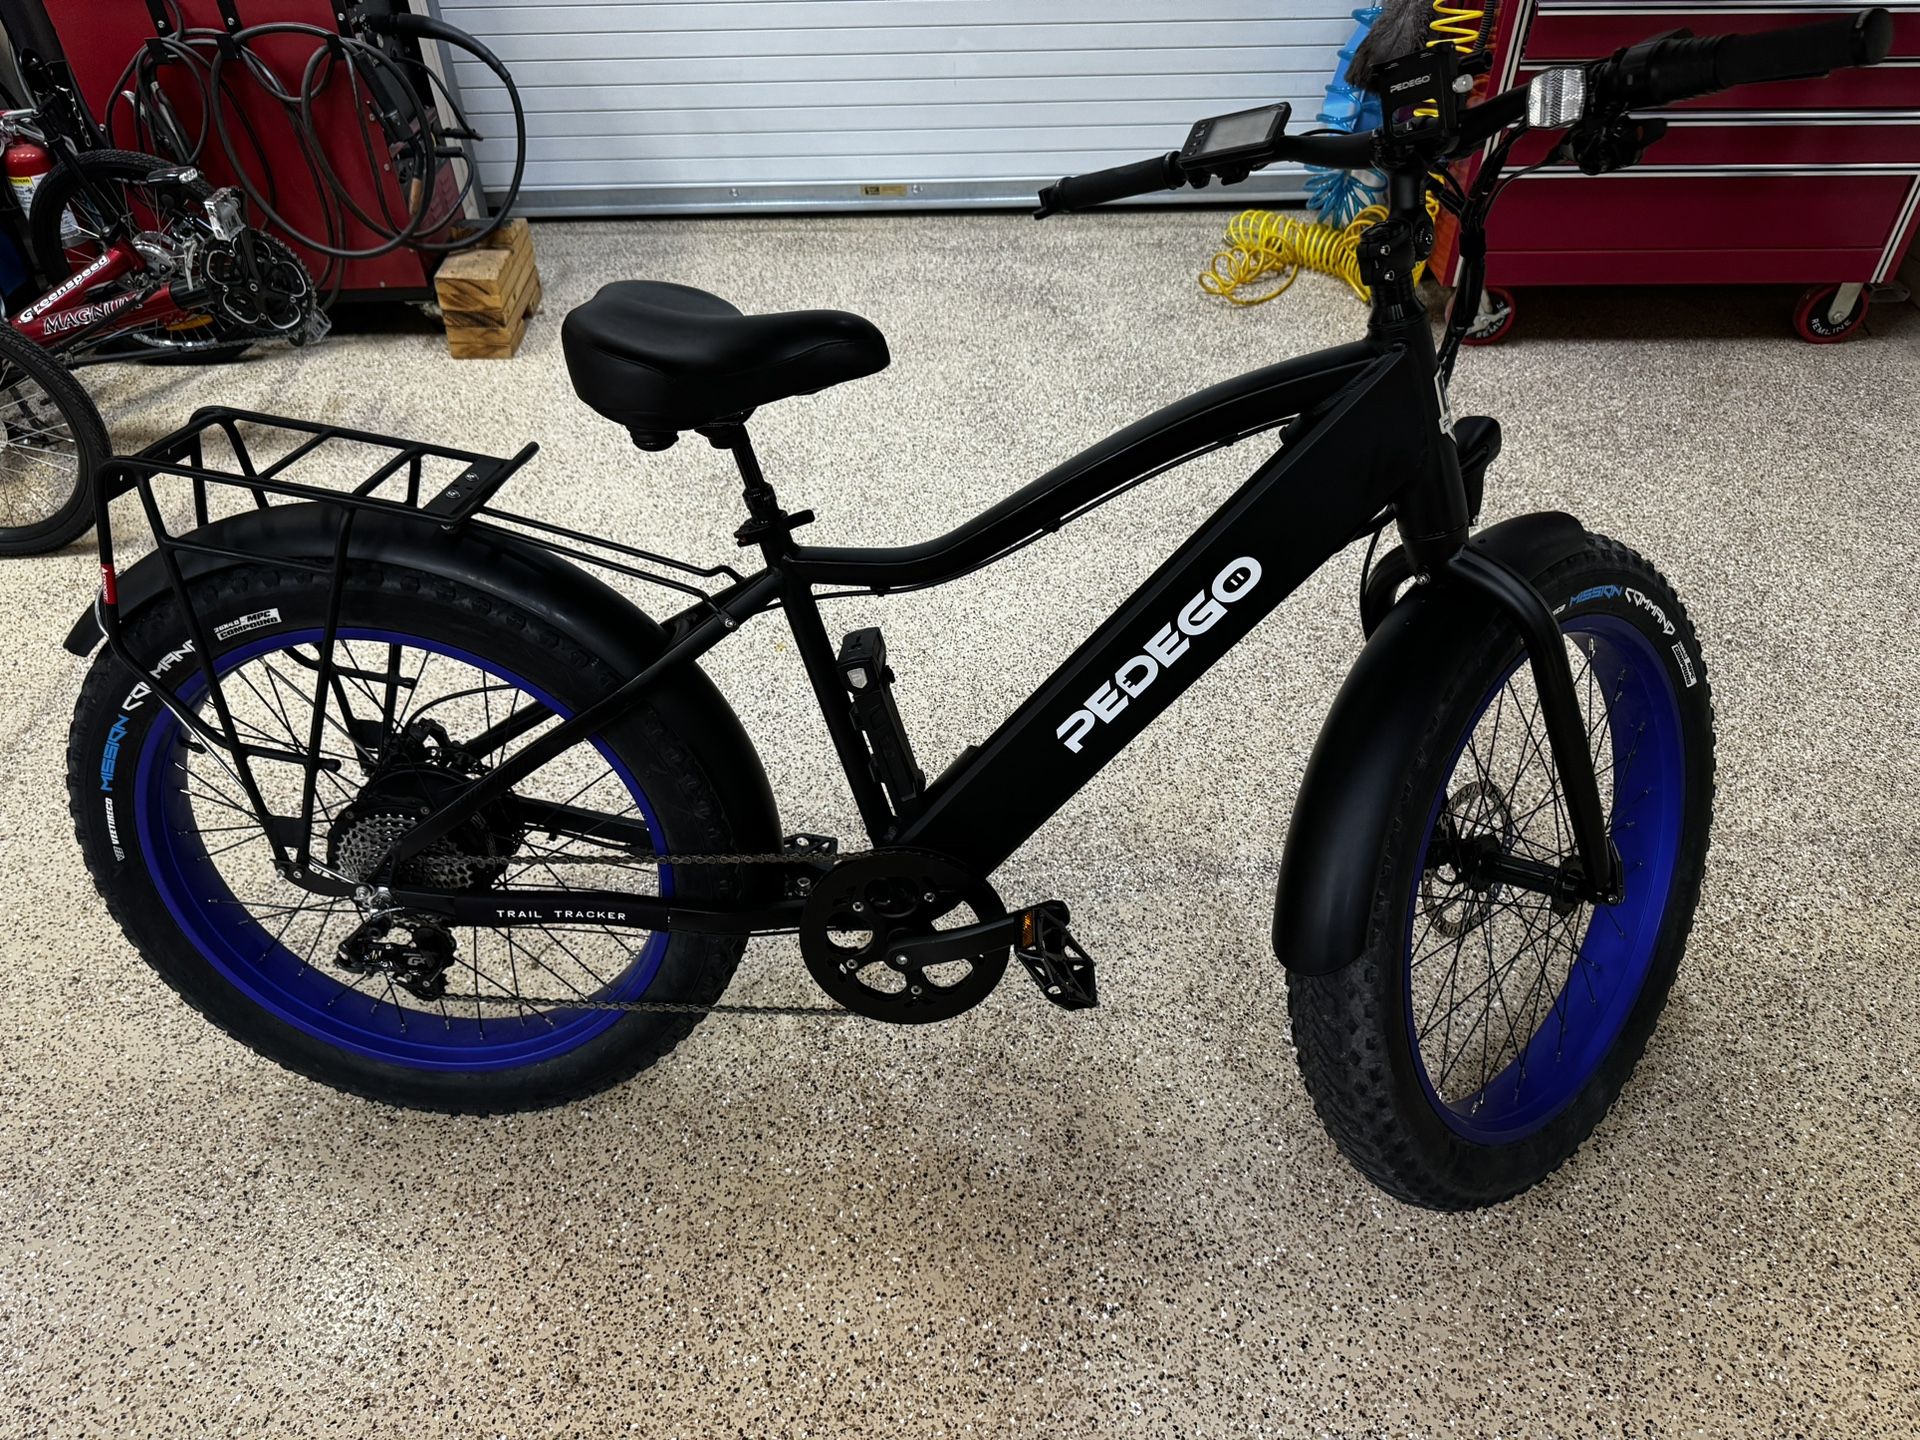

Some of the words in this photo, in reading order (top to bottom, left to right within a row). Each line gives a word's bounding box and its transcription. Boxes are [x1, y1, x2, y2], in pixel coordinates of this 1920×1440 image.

[1390, 75, 1431, 93] PEDEGO
[18, 254, 110, 323] Greenspeed
[1811, 318, 1852, 335] REMLINE
[246, 610, 271, 622] MPC
[1569, 584, 1623, 607] MISSION
[1624, 587, 1676, 636] COMMAND
[220, 617, 278, 638] COMPOUND
[1055, 556, 1263, 754] PEDEGO
[1673, 646, 1692, 686] COMPOUND
[100, 714, 130, 792] MISSION
[121, 639, 196, 711] COMAN
[496, 909, 542, 918] TRAIL
[554, 910, 626, 920] TRACKER
